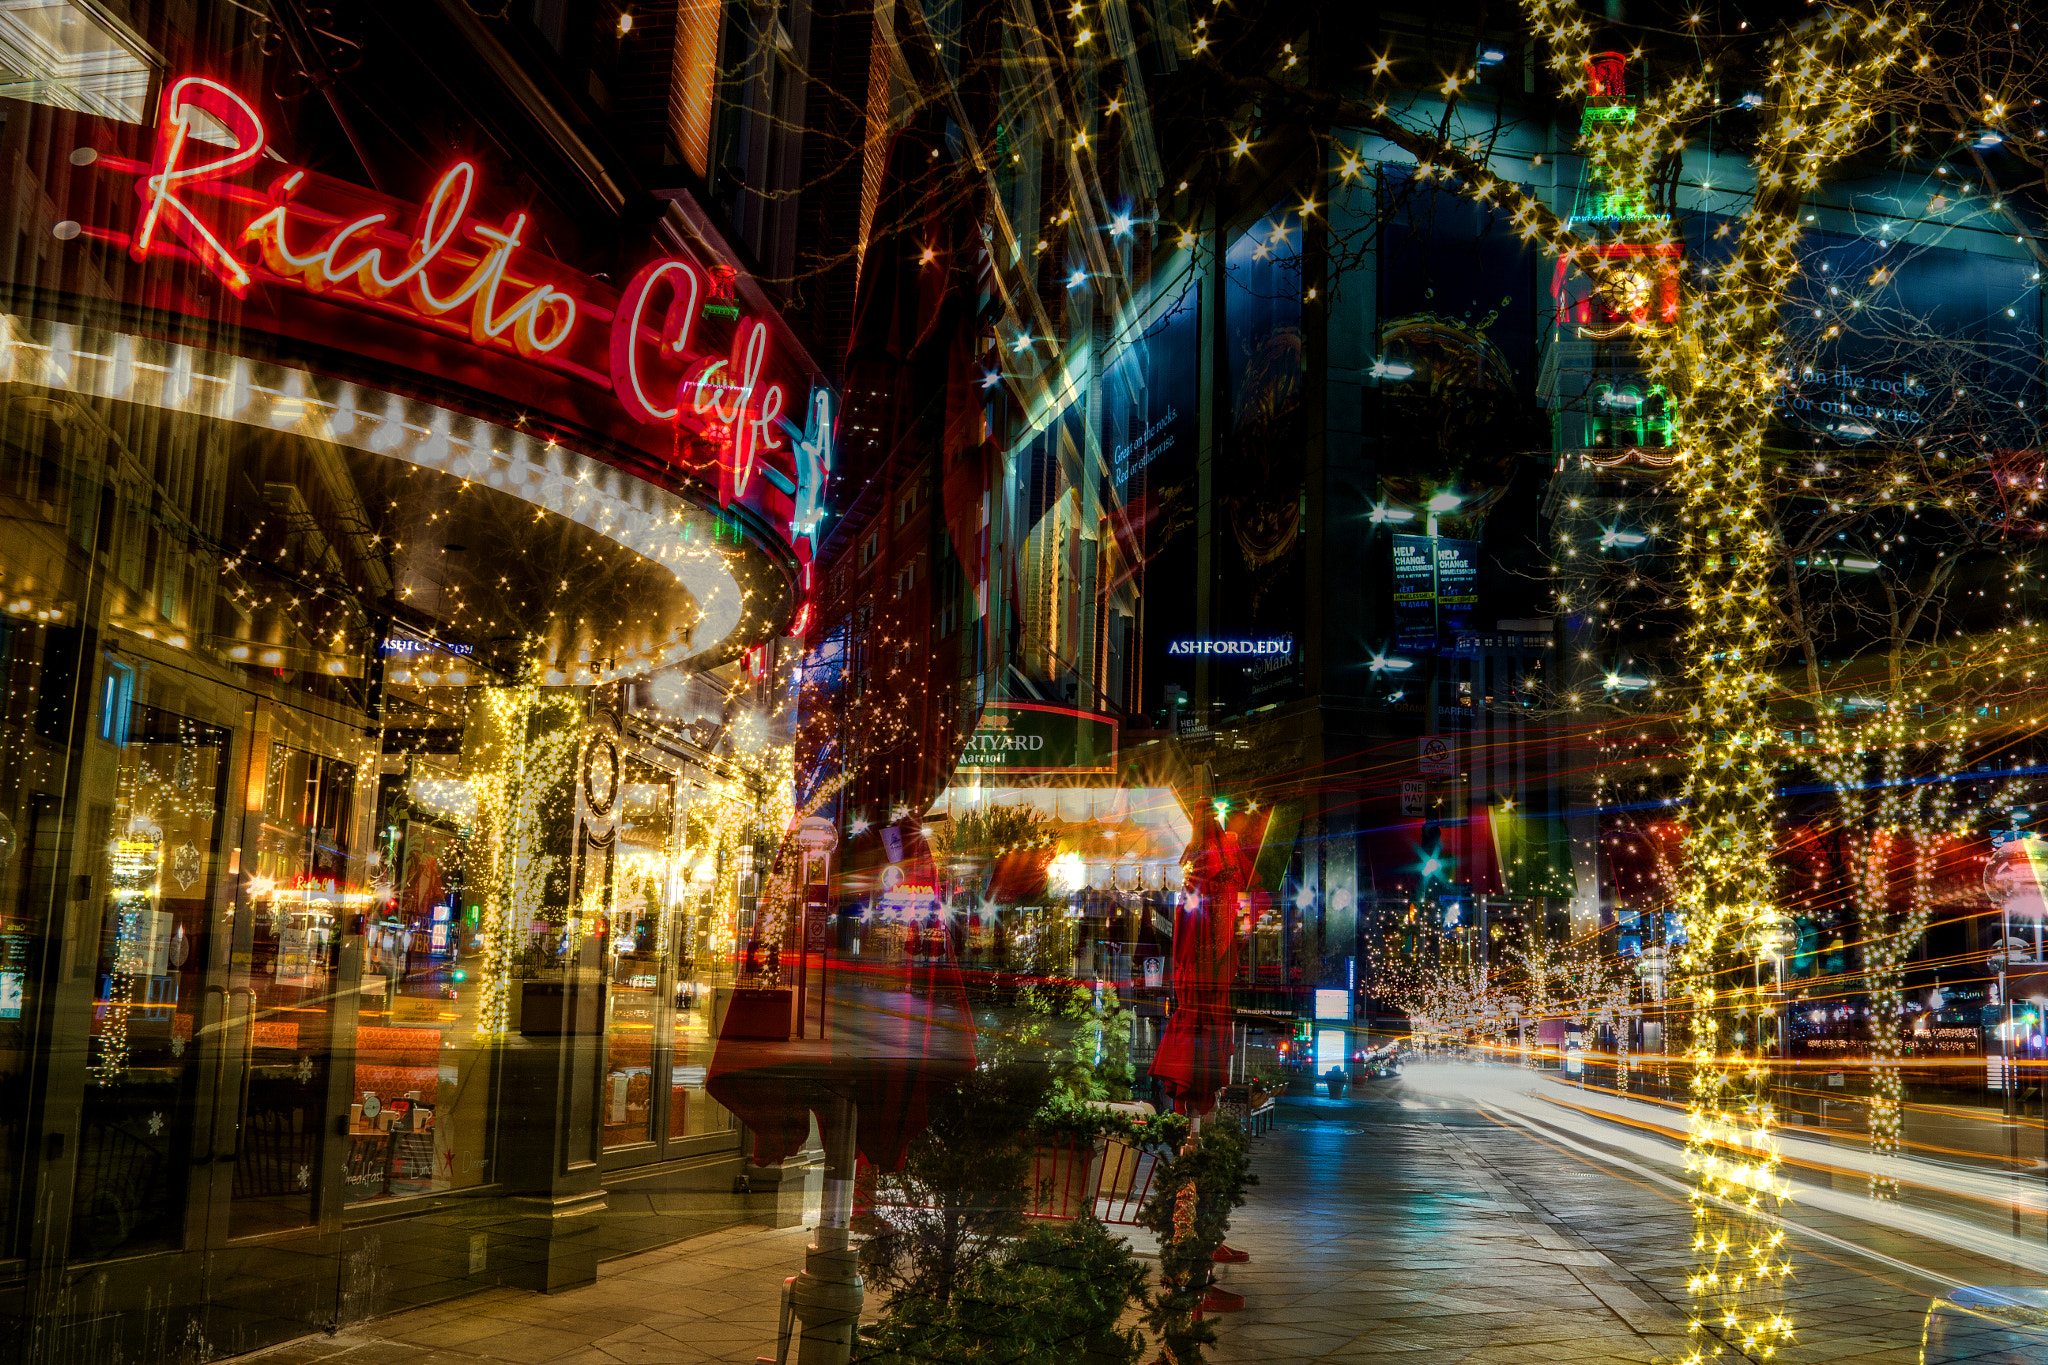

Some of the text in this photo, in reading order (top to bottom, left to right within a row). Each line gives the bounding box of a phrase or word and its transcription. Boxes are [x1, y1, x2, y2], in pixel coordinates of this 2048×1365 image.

[132, 76, 783, 506] Rialto Cafe
[1802, 371, 1827, 385] on
[1835, 365, 1865, 389] the
[1871, 372, 1929, 397] rocks.
[1793, 397, 1815, 411] or
[1820, 393, 1925, 424] otherwise.
[1114, 404, 1178, 465] Great on the rocks.
[1115, 433, 1175, 488] Red or otherwise.
[1393, 546, 1416, 557] HELP
[1437, 550, 1460, 560] HELP
[1394, 556, 1426, 565] CHANGE
[1439, 560, 1469, 568] CHANGE
[1395, 564, 1434, 572] HOMELESSNESS
[1168, 640, 1291, 654] ASHFORD.EDU
[1264, 653, 1293, 674] Mark
[1438, 706, 1476, 717] BARREL
[1180, 718, 1200, 728] HELP
[1181, 724, 1209, 734] CHANGE
[964, 735, 1044, 751] RTYARD
[1404, 782, 1423, 793] ONE
[1404, 793, 1423, 803] WAY
[893, 884, 935, 896] MENYA
[401, 913, 433, 932] HAPPY
[411, 1155, 434, 1180] Lunc
